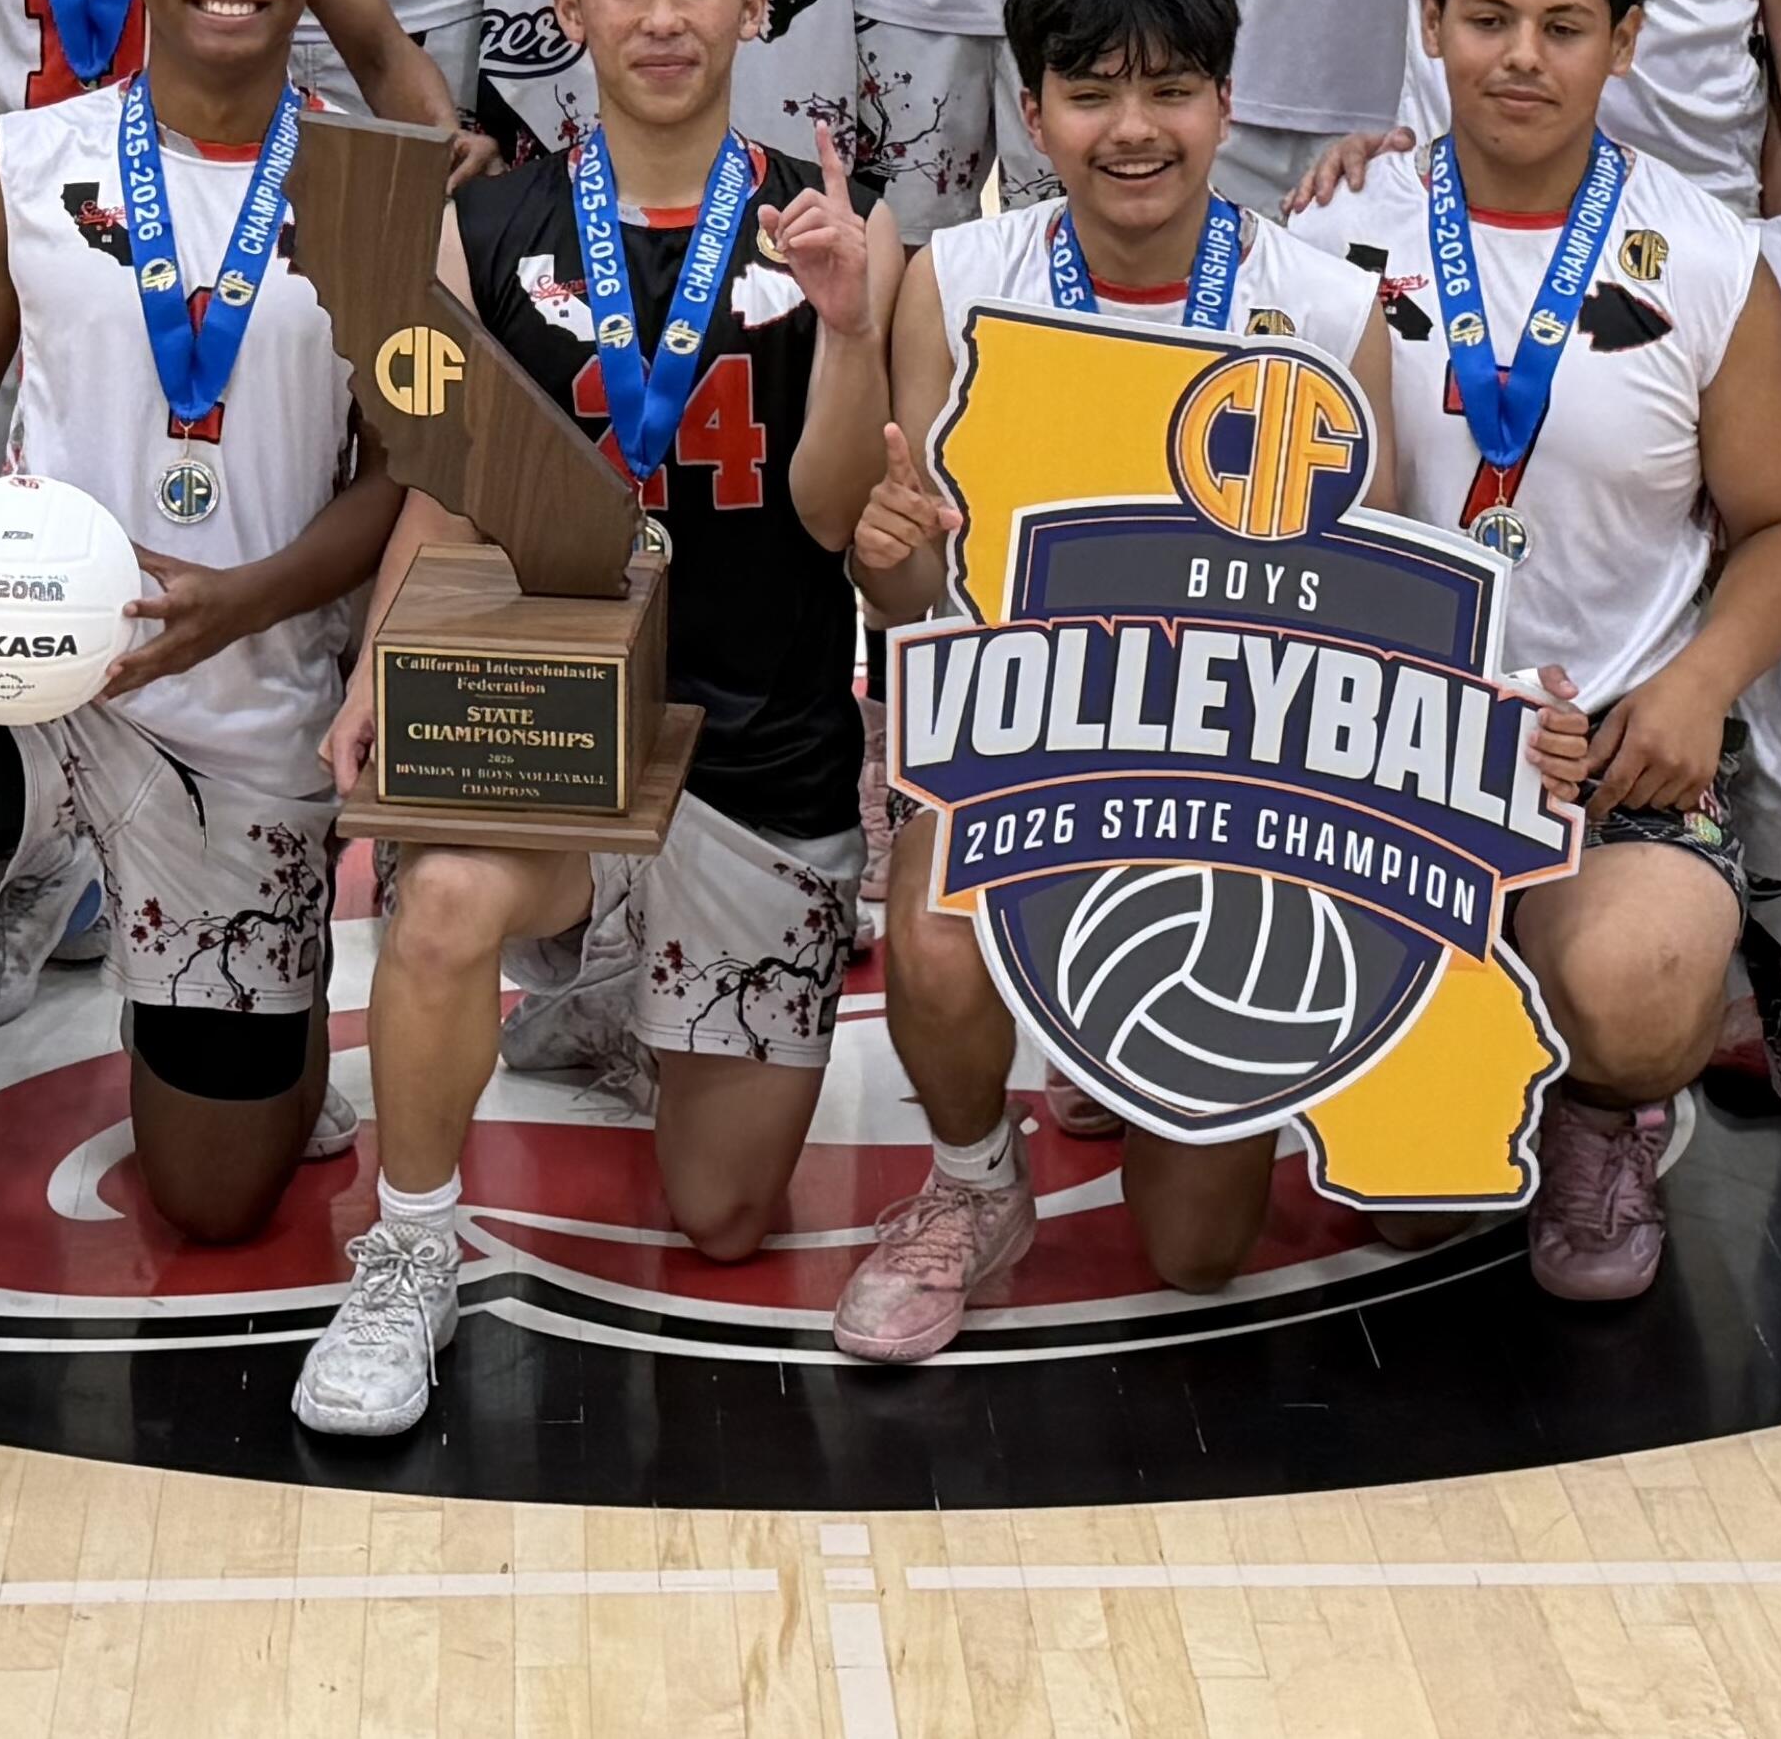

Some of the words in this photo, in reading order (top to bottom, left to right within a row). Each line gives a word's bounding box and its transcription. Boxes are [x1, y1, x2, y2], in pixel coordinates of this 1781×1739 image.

[125, 86, 162, 242] 2025-2026
[238, 102, 298, 255] CHAMPIONSHIPS
[581, 144, 621, 297] 2025-2026
[684, 152, 746, 303] CHAMPIONSHIPS
[1430, 146, 1471, 297] 2025-2026
[1552, 144, 1619, 296] CHAMPIONSHIPS
[375, 326, 466, 416] CIF
[1175, 355, 1360, 541] CIF
[1186, 556, 1320, 611] BOYS
[396, 655, 480, 673] California
[486, 660, 607, 680] Interscholastic
[457, 678, 545, 694] Federation
[467, 706, 534, 725] STATE
[408, 723, 595, 749] CHAMPIONSHIPS
[462, 784, 540, 797] CHAMPIONS
[478, 769, 513, 780] BOYS
[518, 771, 607, 785] VOLLEYBALL
[906, 628, 1565, 851] VOLLEYBALL
[964, 803, 1077, 864] 2026
[1101, 798, 1230, 843] STATE
[1256, 807, 1476, 926] CHAMPION
